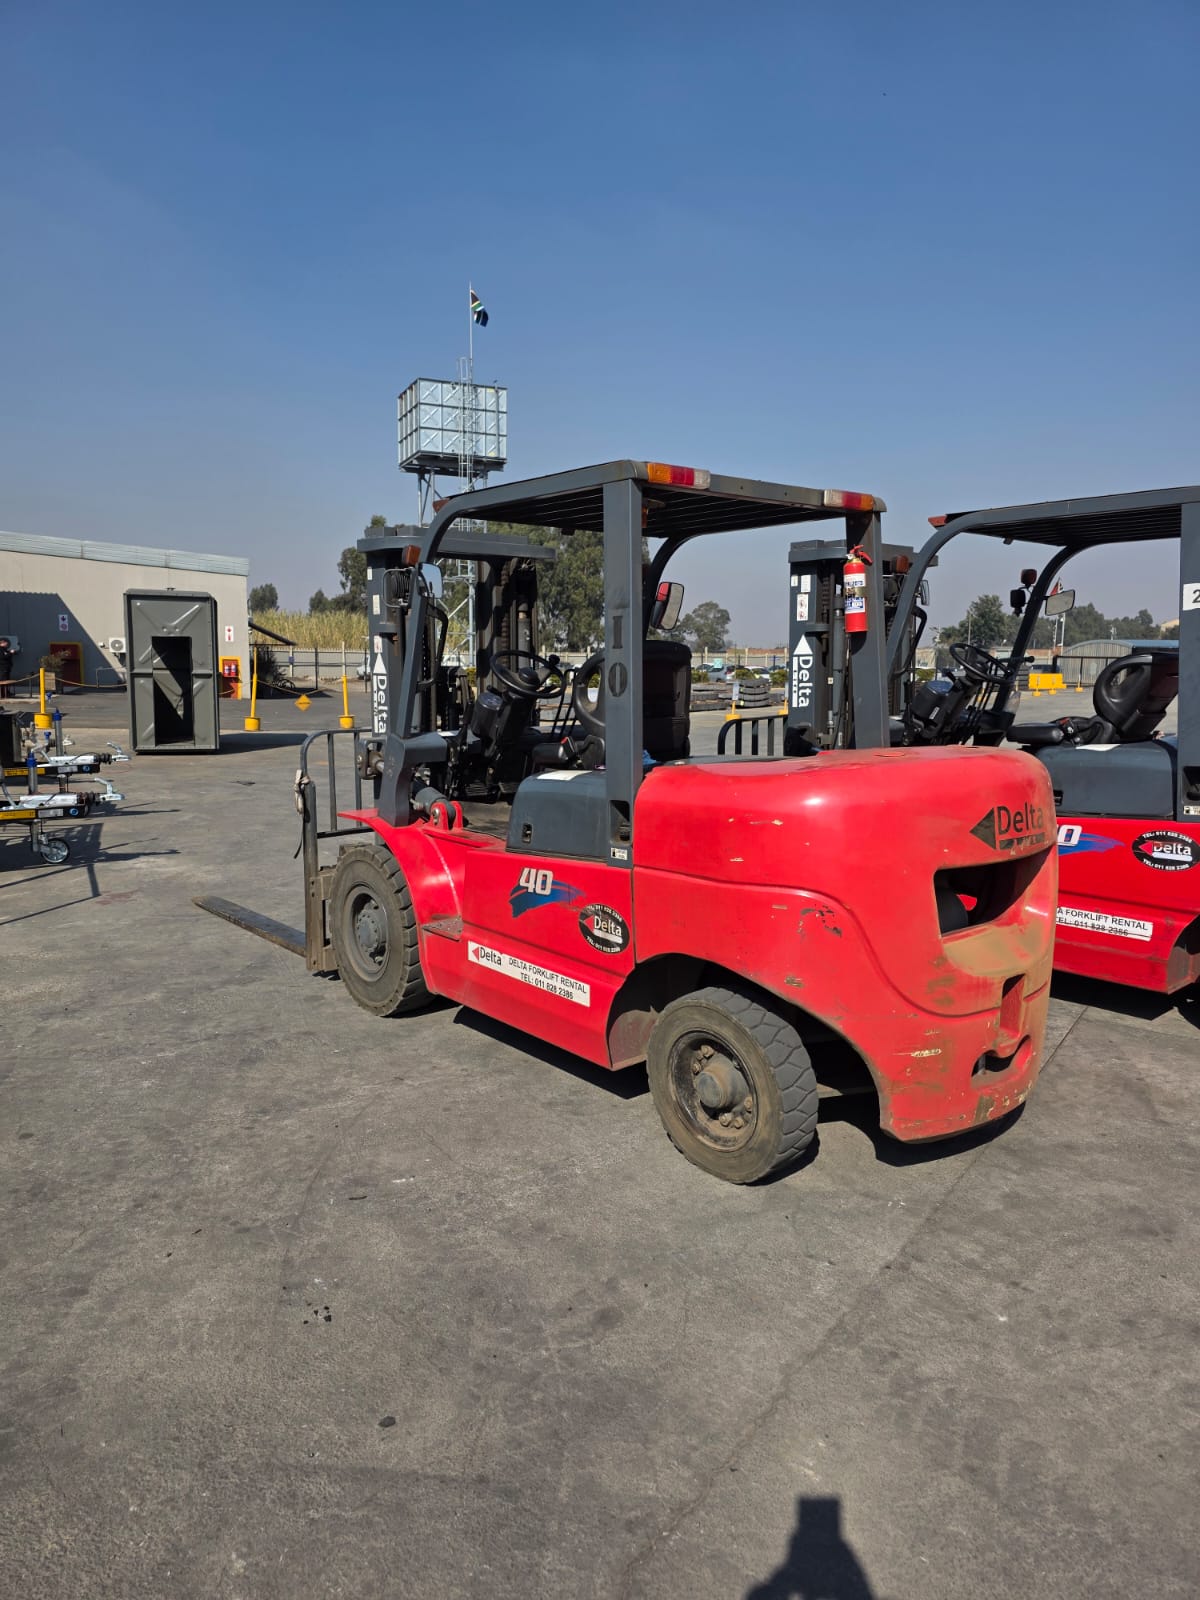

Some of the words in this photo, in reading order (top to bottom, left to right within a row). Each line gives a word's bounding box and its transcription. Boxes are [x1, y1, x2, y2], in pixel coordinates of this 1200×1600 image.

[798, 656, 814, 708] Delta
[377, 675, 389, 734] Delta
[997, 801, 1045, 836] Delta
[1056, 825, 1083, 847] 0
[1153, 841, 1192, 856] Delta
[519, 867, 554, 896] 40
[594, 915, 622, 937] Delta
[1065, 909, 1110, 924] FORKLIFT
[1111, 917, 1149, 931] RENTAL
[1074, 920, 1088, 929] 011
[480, 946, 502, 966] Delta
[508, 957, 528, 971] DELTA
[528, 965, 559, 983] FORKLIFT
[560, 977, 587, 994] RENTAL
[520, 972, 534, 985] TEL:
[535, 978, 545, 989] 011
[546, 982, 557, 993] 828
